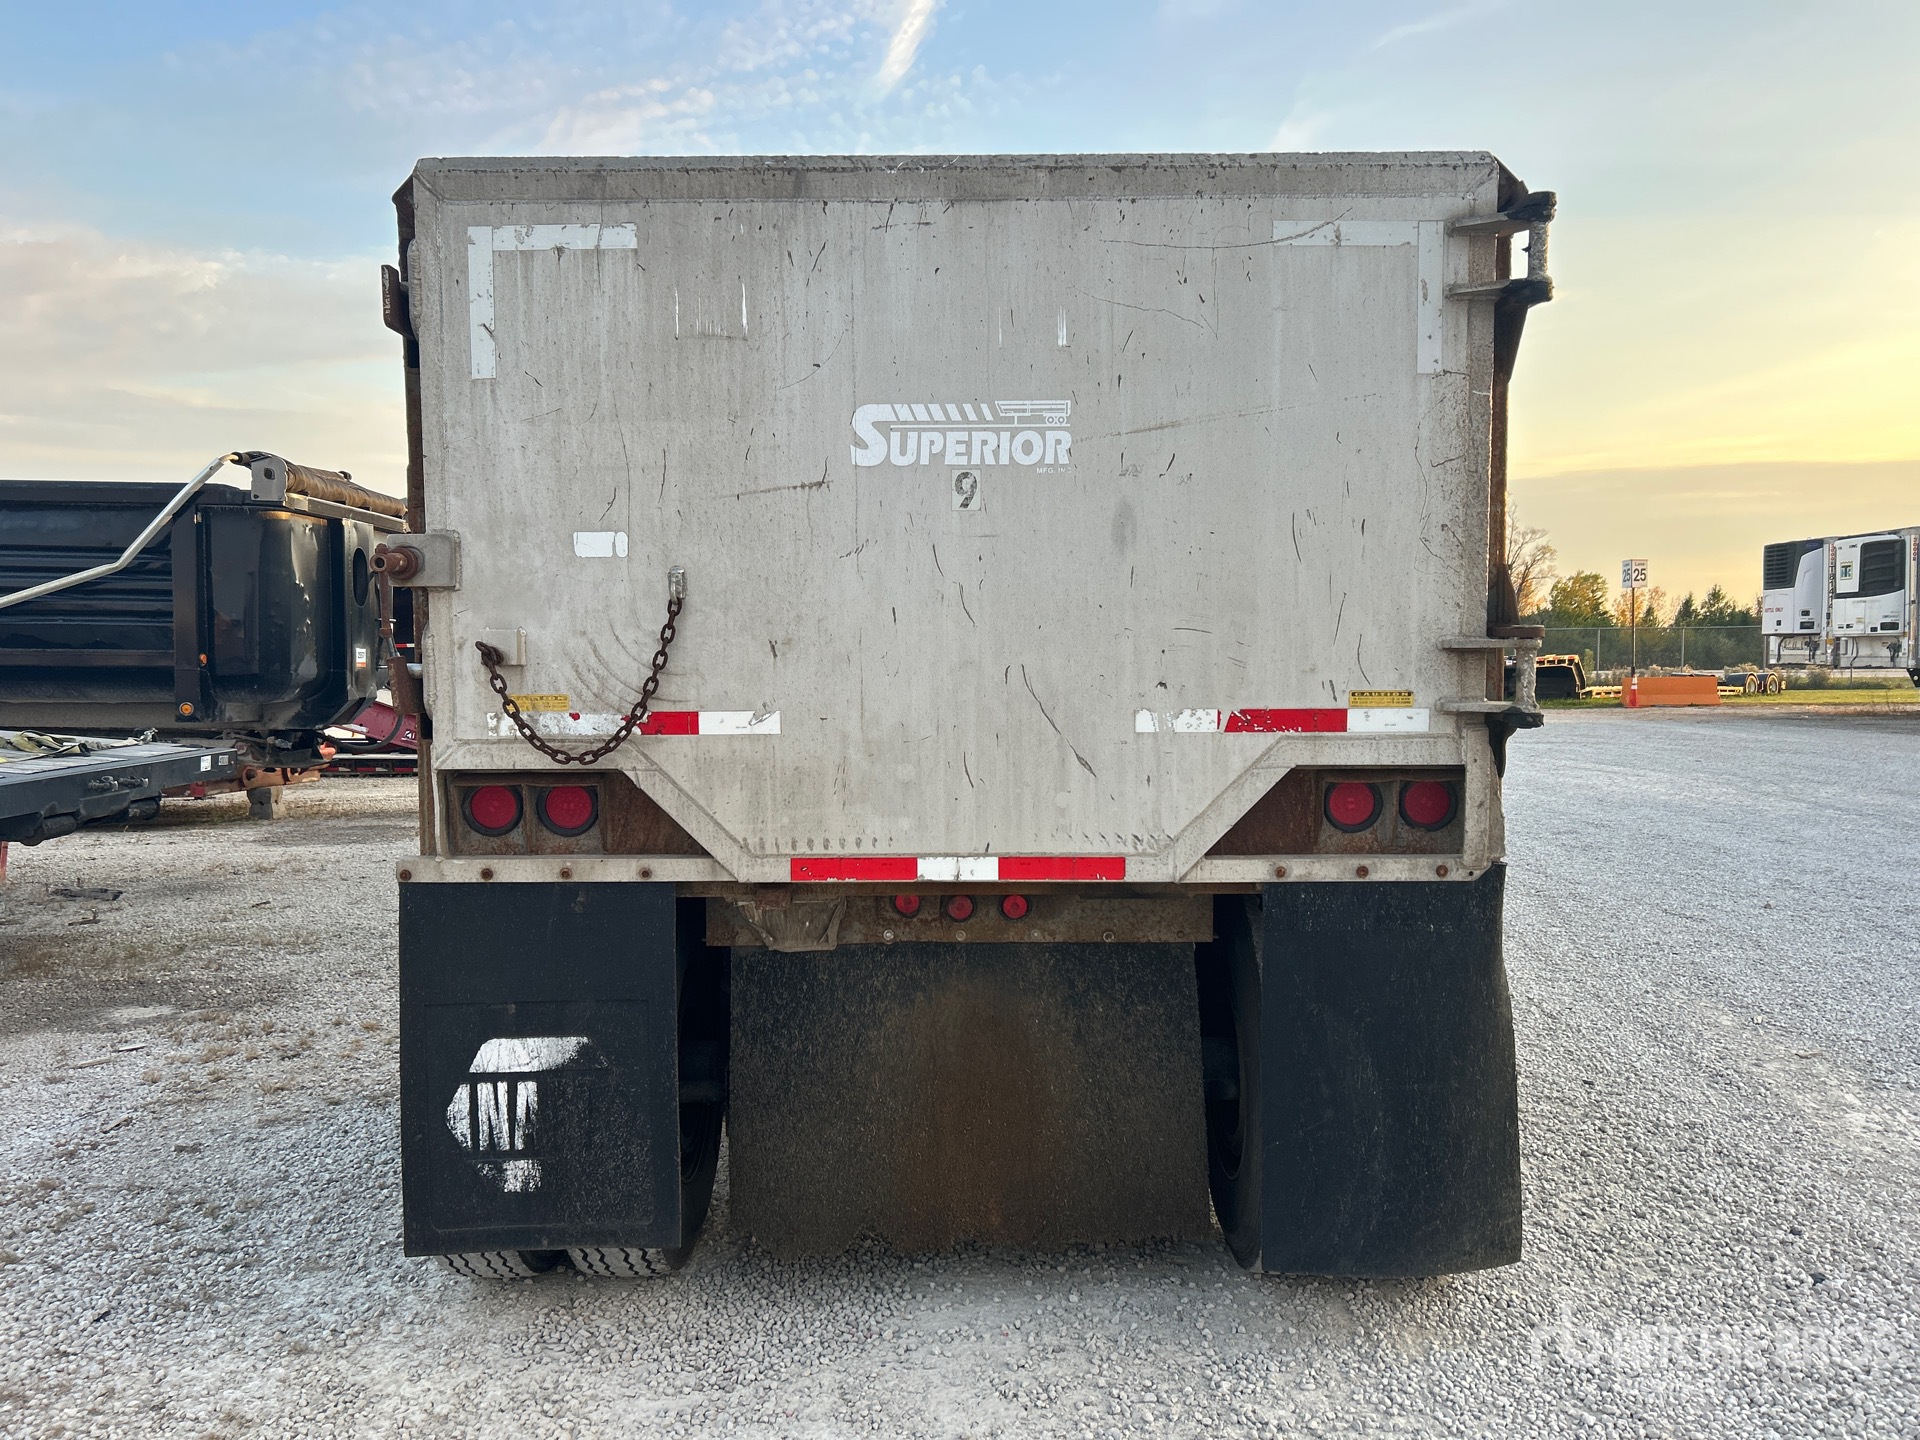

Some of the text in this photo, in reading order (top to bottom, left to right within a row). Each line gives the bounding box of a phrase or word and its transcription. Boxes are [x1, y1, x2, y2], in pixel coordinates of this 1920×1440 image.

[850, 403, 1072, 467] SUPERIOR
[954, 471, 978, 509] 9
[1622, 569, 1631, 582] 25
[1633, 568, 1647, 582] 25
